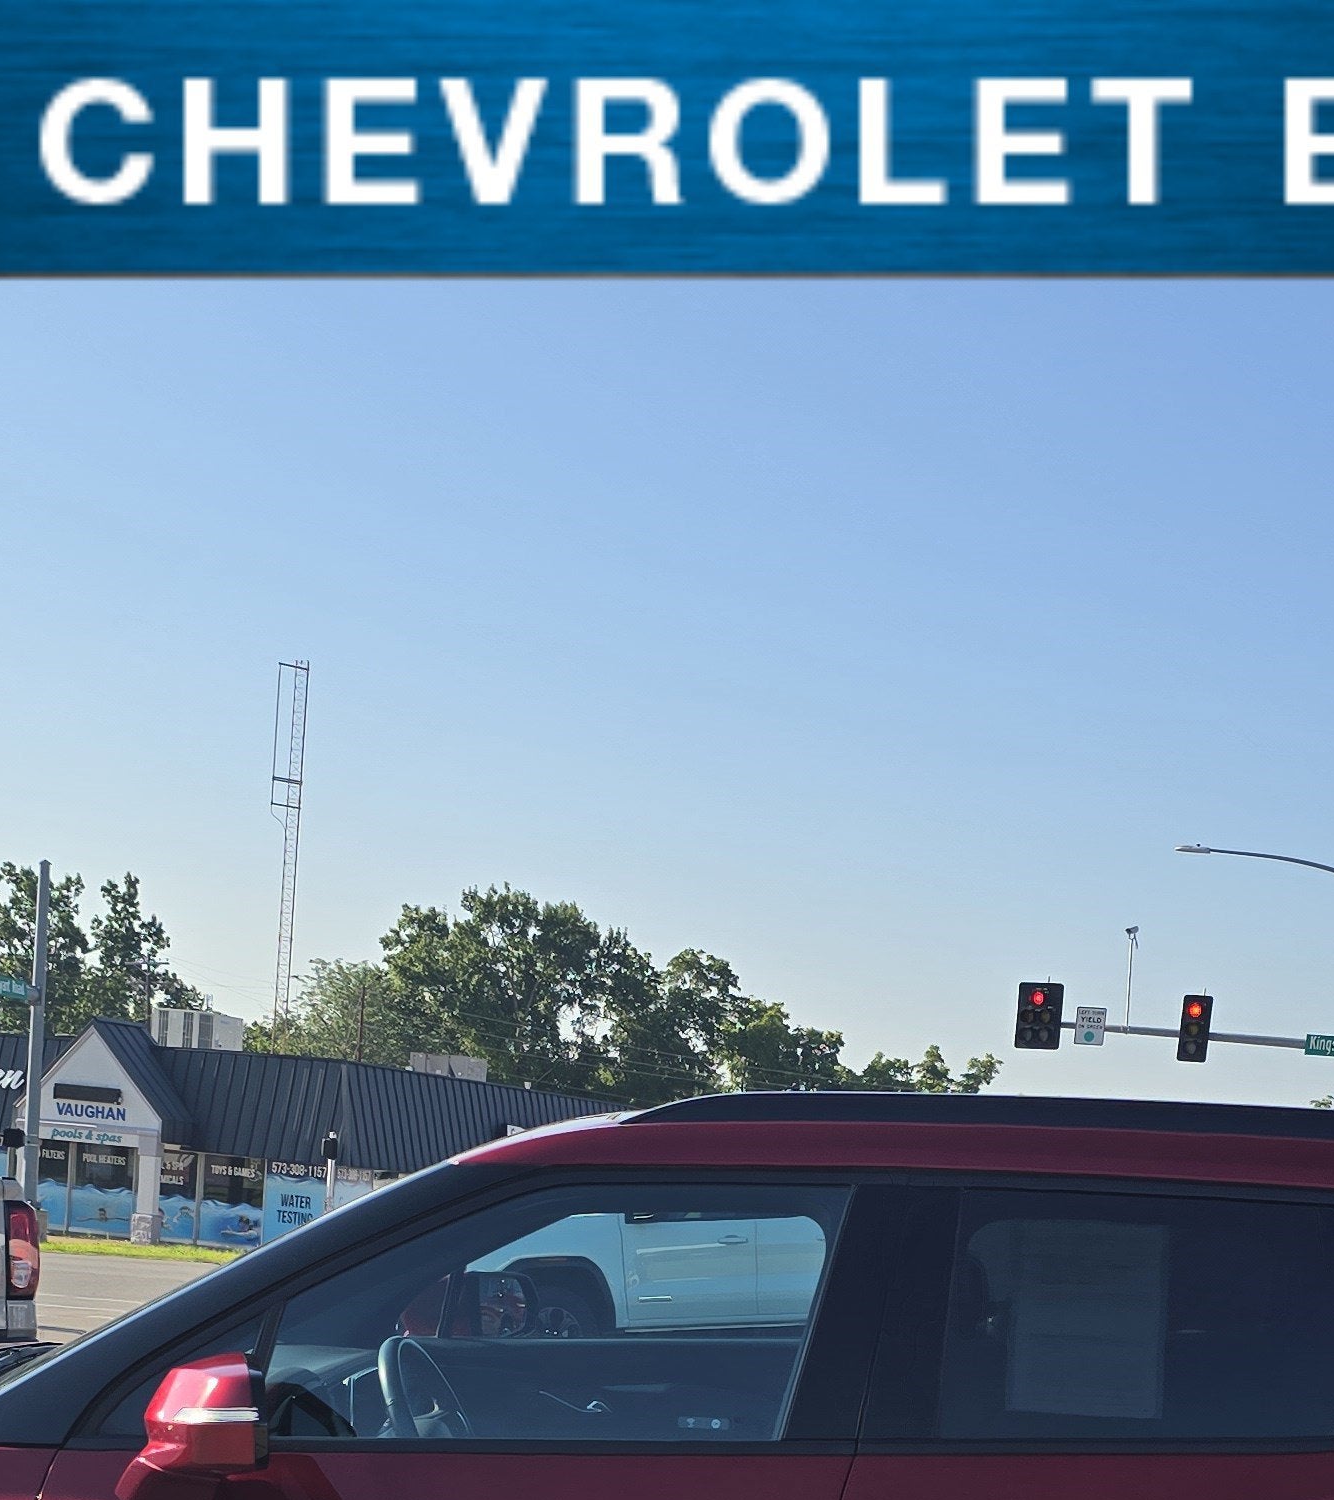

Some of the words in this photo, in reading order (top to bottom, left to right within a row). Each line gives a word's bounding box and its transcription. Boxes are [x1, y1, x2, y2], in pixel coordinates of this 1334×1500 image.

[1081, 1016, 1102, 1024] YIELD
[55, 1101, 127, 1122] VAUGHAN
[51, 1127, 84, 1140] pools
[85, 1130, 93, 1139] &
[95, 1132, 123, 1145] spas
[41, 1148, 66, 1161] FILTERS
[82, 1152, 98, 1164] POOL
[98, 1154, 127, 1167] HEATERS
[210, 1164, 227, 1176] TOYS
[233, 1167, 256, 1179] GAMES
[271, 1161, 327, 1179] 573-308-1157
[280, 1193, 312, 1210] WATER
